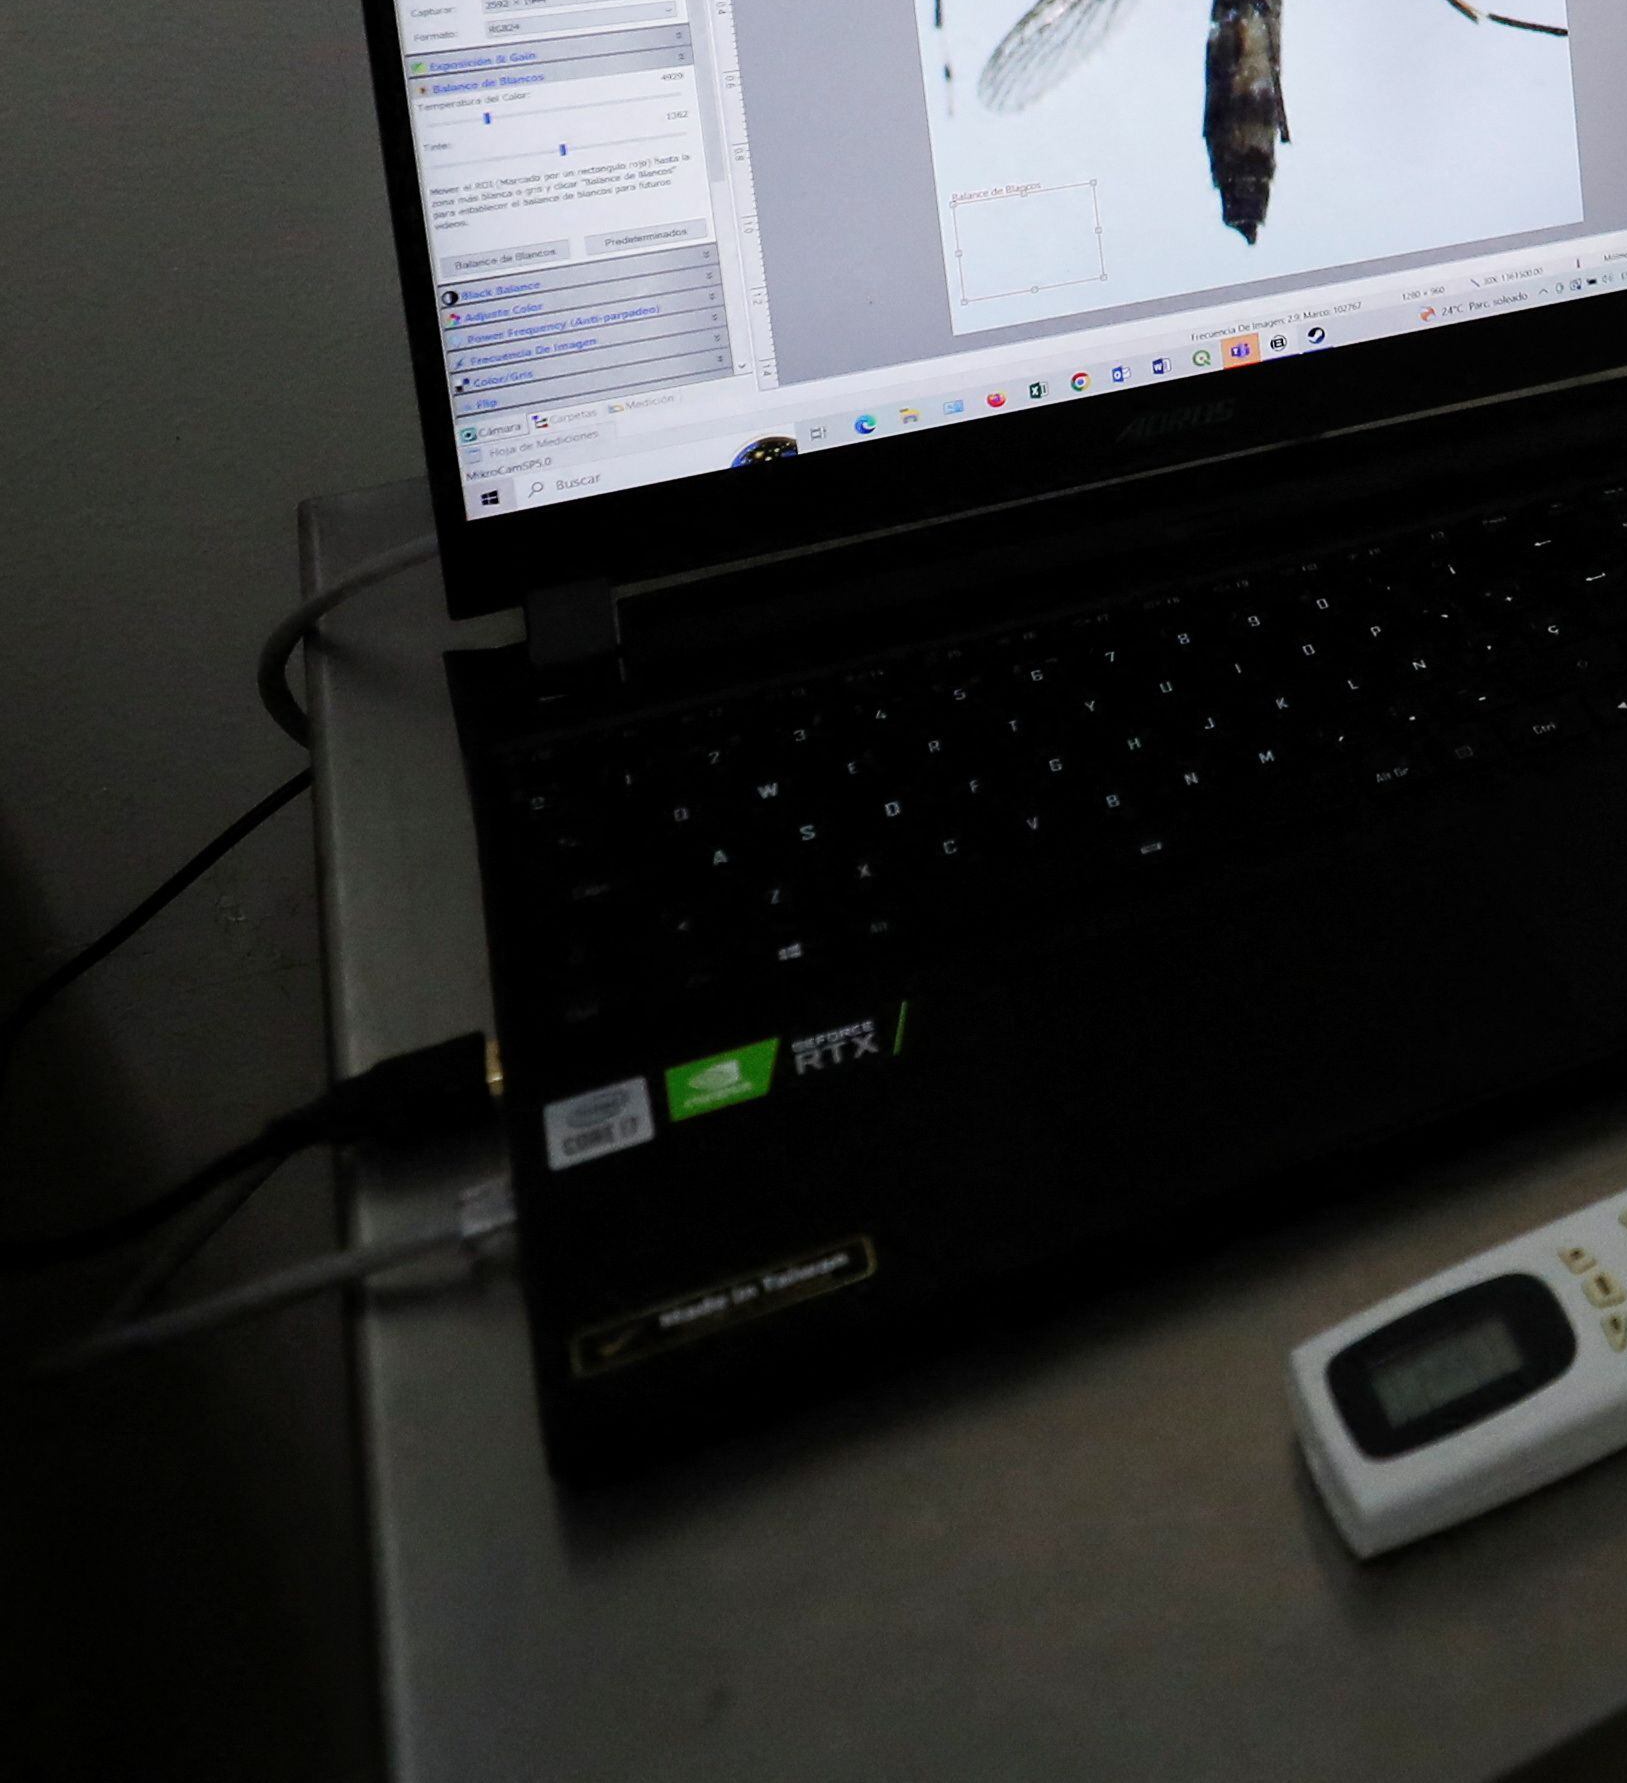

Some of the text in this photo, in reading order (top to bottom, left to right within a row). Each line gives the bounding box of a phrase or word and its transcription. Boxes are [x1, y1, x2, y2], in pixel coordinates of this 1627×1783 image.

[484, 0, 509, 9] 2592
[488, 22, 521, 34] RGB24
[429, 50, 537, 73] Exposición & Gain
[433, 72, 545, 94] Balance de Blancos
[418, 96, 485, 112] Temperatura
[487, 94, 500, 105] del
[429, 185, 460, 196] Mover
[543, 172, 558, 182] por
[562, 170, 574, 179] un
[654, 155, 679, 165] hasta
[431, 198, 454, 209] zona
[481, 190, 513, 202] blanca
[525, 186, 543, 198] gris
[624, 172, 636, 181] de
[991, 187, 1004, 197] de
[433, 209, 456, 222] para
[458, 202, 509, 218] establecer
[523, 194, 558, 207] balance
[562, 192, 574, 201] de
[577, 186, 612, 199] blancos
[615, 184, 636, 196] para
[639, 178, 671, 190] futuros
[605, 228, 688, 247] Predeterminados
[455, 248, 556, 271] Balance de Blancos
[460, 280, 540, 301] Black Balance
[1492, 291, 1529, 308] soleado
[511, 302, 543, 315] Color
[467, 303, 660, 345] Power Frequency (Anti-parpadeo)
[1191, 327, 1236, 342] Frecuencia
[1237, 323, 1251, 333] De
[470, 337, 597, 366] Frecuencia De Imagen
[473, 370, 533, 389] Color/Gris
[476, 398, 498, 411] Flip
[548, 408, 598, 425] Carpetas
[625, 393, 674, 410] Medición
[489, 429, 599, 458] Hoja de Mediciones
[556, 472, 600, 492] Buscar
[1247, 615, 1261, 627] 9
[1370, 625, 1382, 637] P
[1177, 632, 1191, 645] 8
[1104, 651, 1115, 663] 7
[1030, 669, 1044, 681] 6
[1159, 681, 1173, 694] U
[1347, 679, 1359, 690] L
[953, 688, 967, 701] 5
[1084, 700, 1096, 712] Y
[1275, 697, 1288, 710] K
[875, 709, 887, 720] 4
[1008, 719, 1017, 732] T
[1204, 717, 1215, 730] J
[1531, 721, 1558, 735] Ctrl
[793, 729, 806, 742] 3
[928, 740, 940, 753] R
[1127, 737, 1142, 751] H
[708, 751, 720, 765] 2
[1258, 750, 1275, 764] M
[847, 761, 856, 774] E
[969, 779, 979, 793] F
[1184, 772, 1199, 786] N
[757, 782, 778, 799] W
[1105, 794, 1121, 808] B
[1026, 816, 1038, 830] V
[799, 824, 816, 841] S
[943, 839, 957, 855] C
[713, 849, 728, 865] A
[793, 1032, 880, 1077] RTX
[659, 1295, 730, 1328] Made
[762, 1251, 850, 1293] Taiwan
